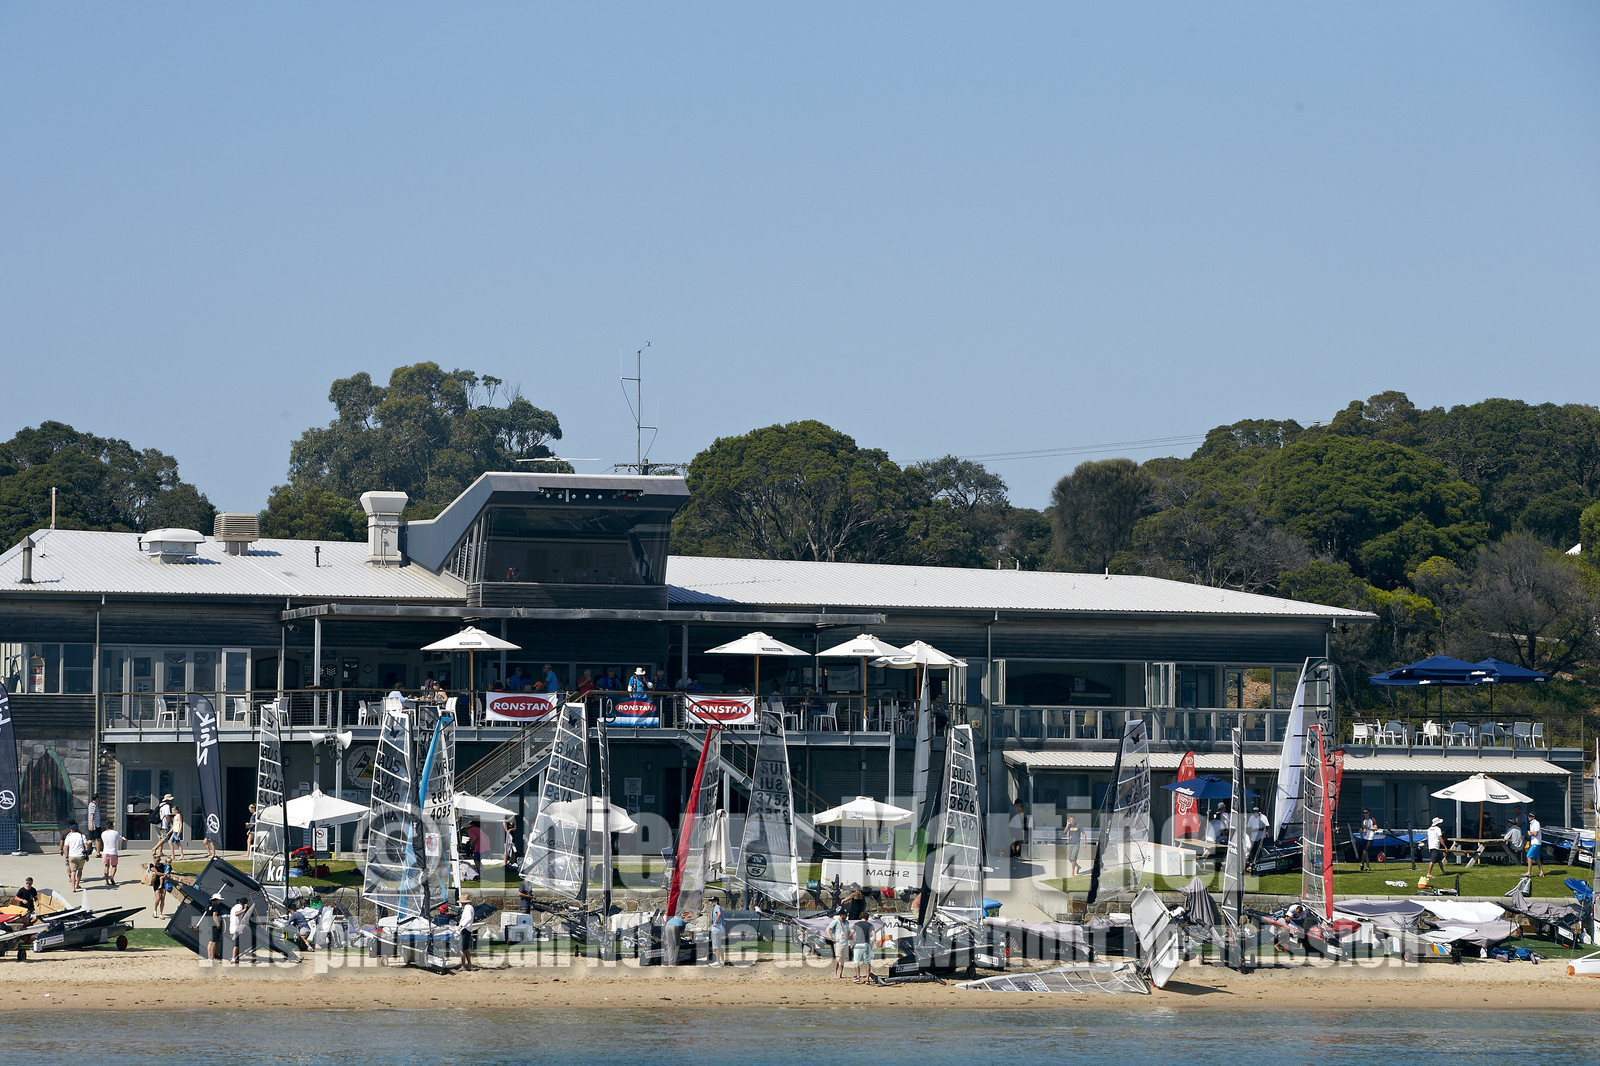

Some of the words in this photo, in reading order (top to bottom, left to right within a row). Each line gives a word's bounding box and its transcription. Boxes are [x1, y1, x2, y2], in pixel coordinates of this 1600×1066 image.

[493, 701, 550, 712] RONSTAN
[616, 702, 654, 712] RONSTAN
[691, 703, 748, 715] RONSTAN
[262, 746, 279, 761] AUS
[377, 752, 401, 773] AUS
[953, 769, 972, 783] AUS
[374, 787, 400, 805] 4020
[757, 792, 790, 806] 3752
[431, 804, 451, 821] 4095
[950, 797, 975, 814] 3676
[865, 869, 900, 877] MACH
